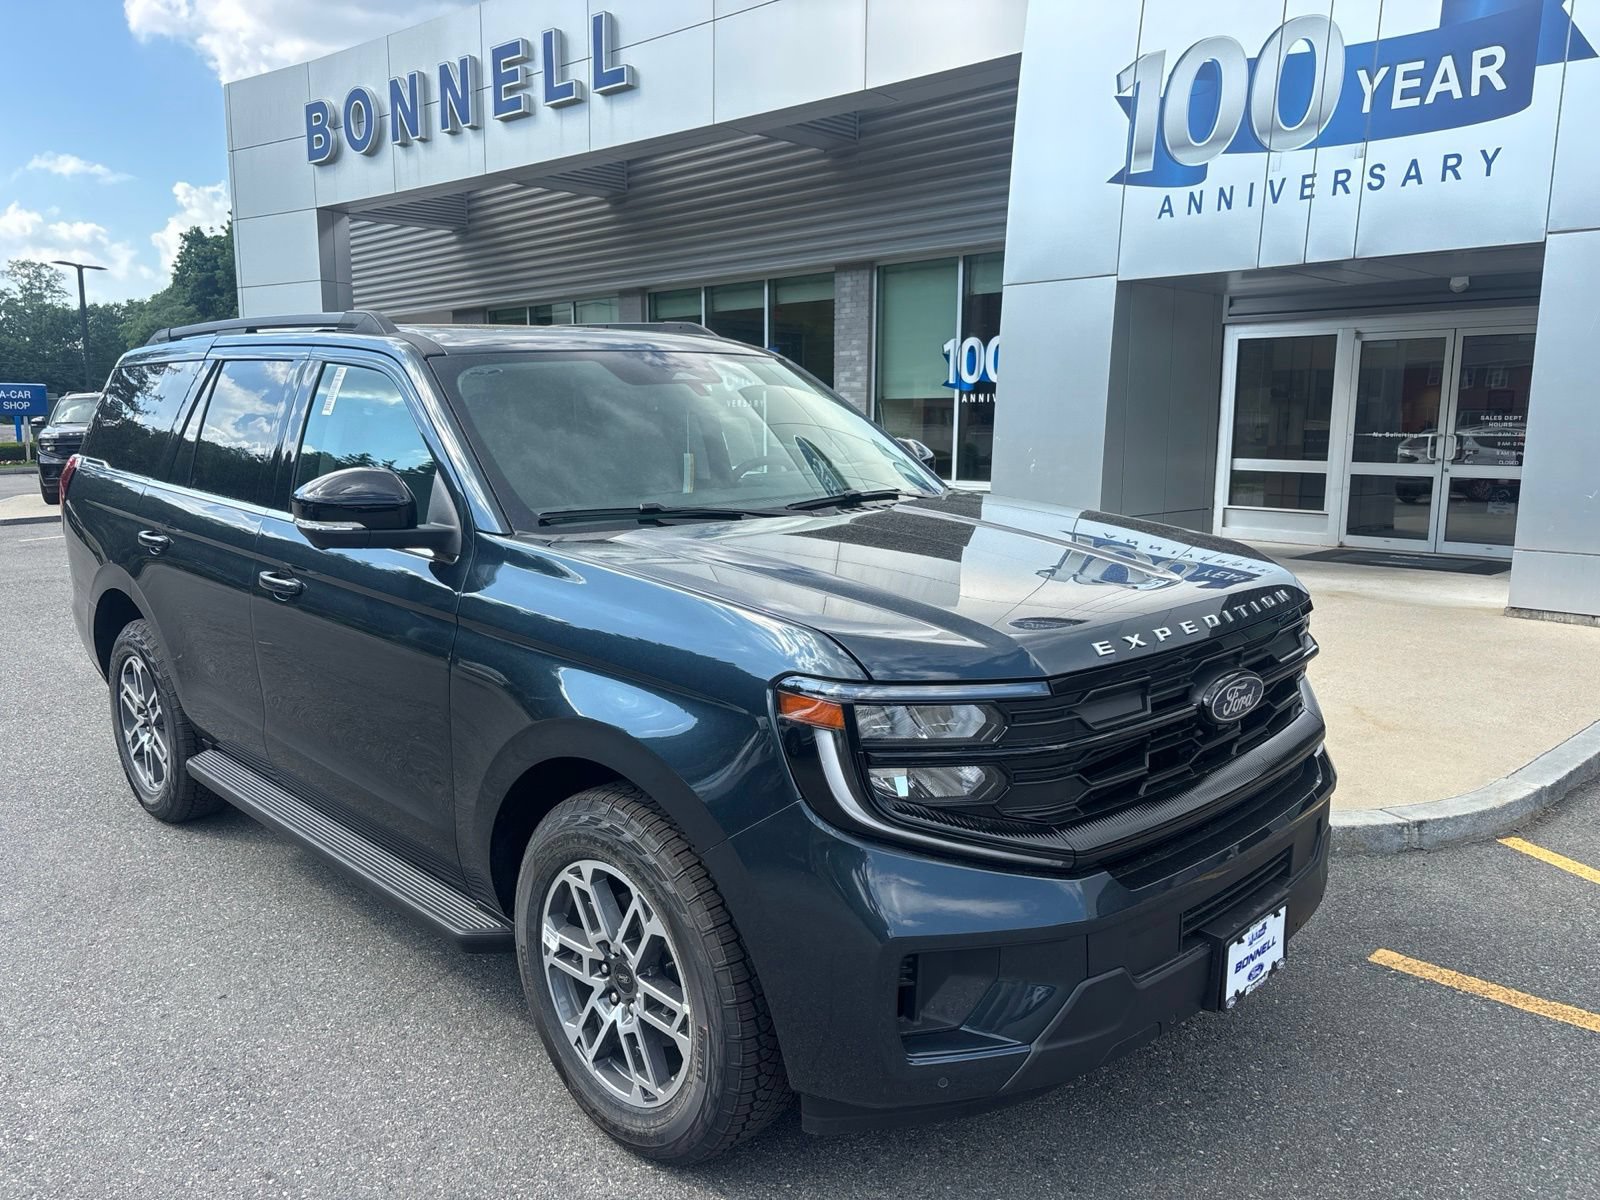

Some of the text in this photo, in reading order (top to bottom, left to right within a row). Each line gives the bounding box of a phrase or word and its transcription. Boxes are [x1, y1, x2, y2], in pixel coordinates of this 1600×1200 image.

[304, 11, 636, 165] BONNELL
[1116, 14, 1508, 175] 100 YEAR
[1157, 147, 1503, 220] ANNIVERSARY
[3, 401, 31, 410] SHOP
[1091, 589, 1291, 657] EXPEDITION
[1222, 682, 1255, 716] Ford
[1234, 936, 1276, 975] BONNELL
